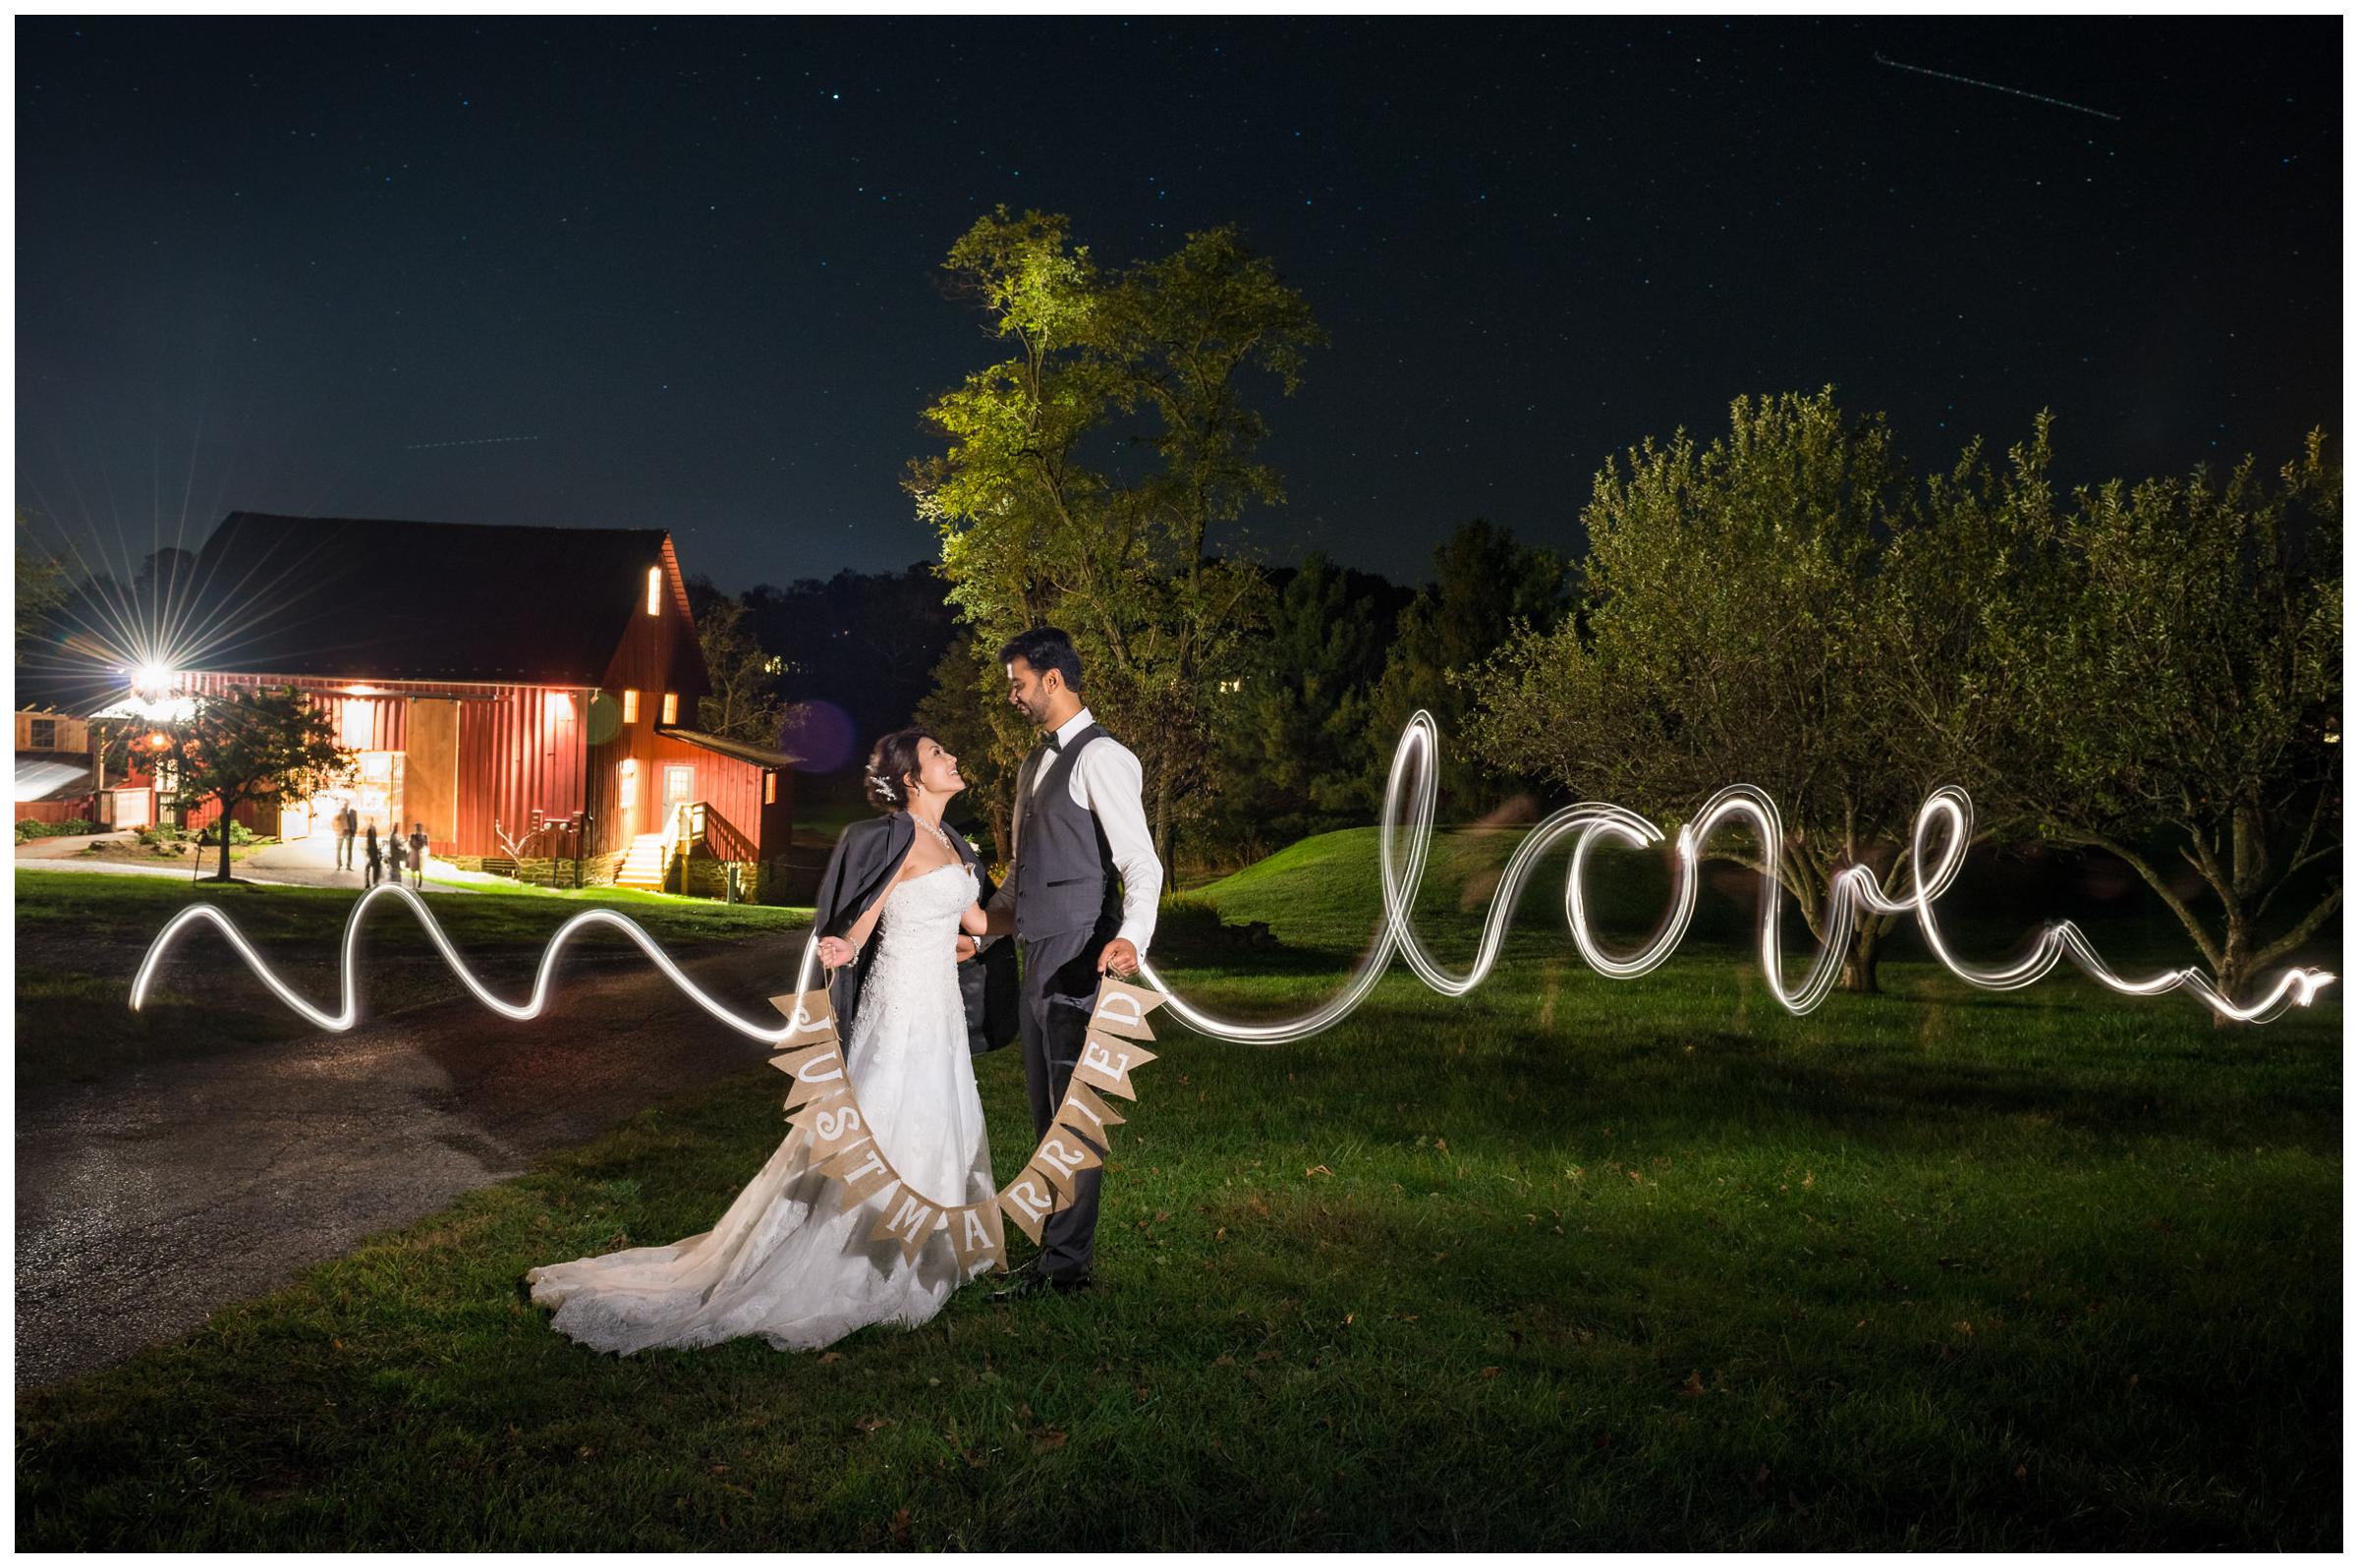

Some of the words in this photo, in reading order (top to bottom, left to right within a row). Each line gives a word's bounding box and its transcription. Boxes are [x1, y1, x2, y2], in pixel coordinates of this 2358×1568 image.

[1377, 707, 2063, 1016] love
[795, 1007, 887, 1186] JUST
[885, 990, 1143, 1253] MARRIED
